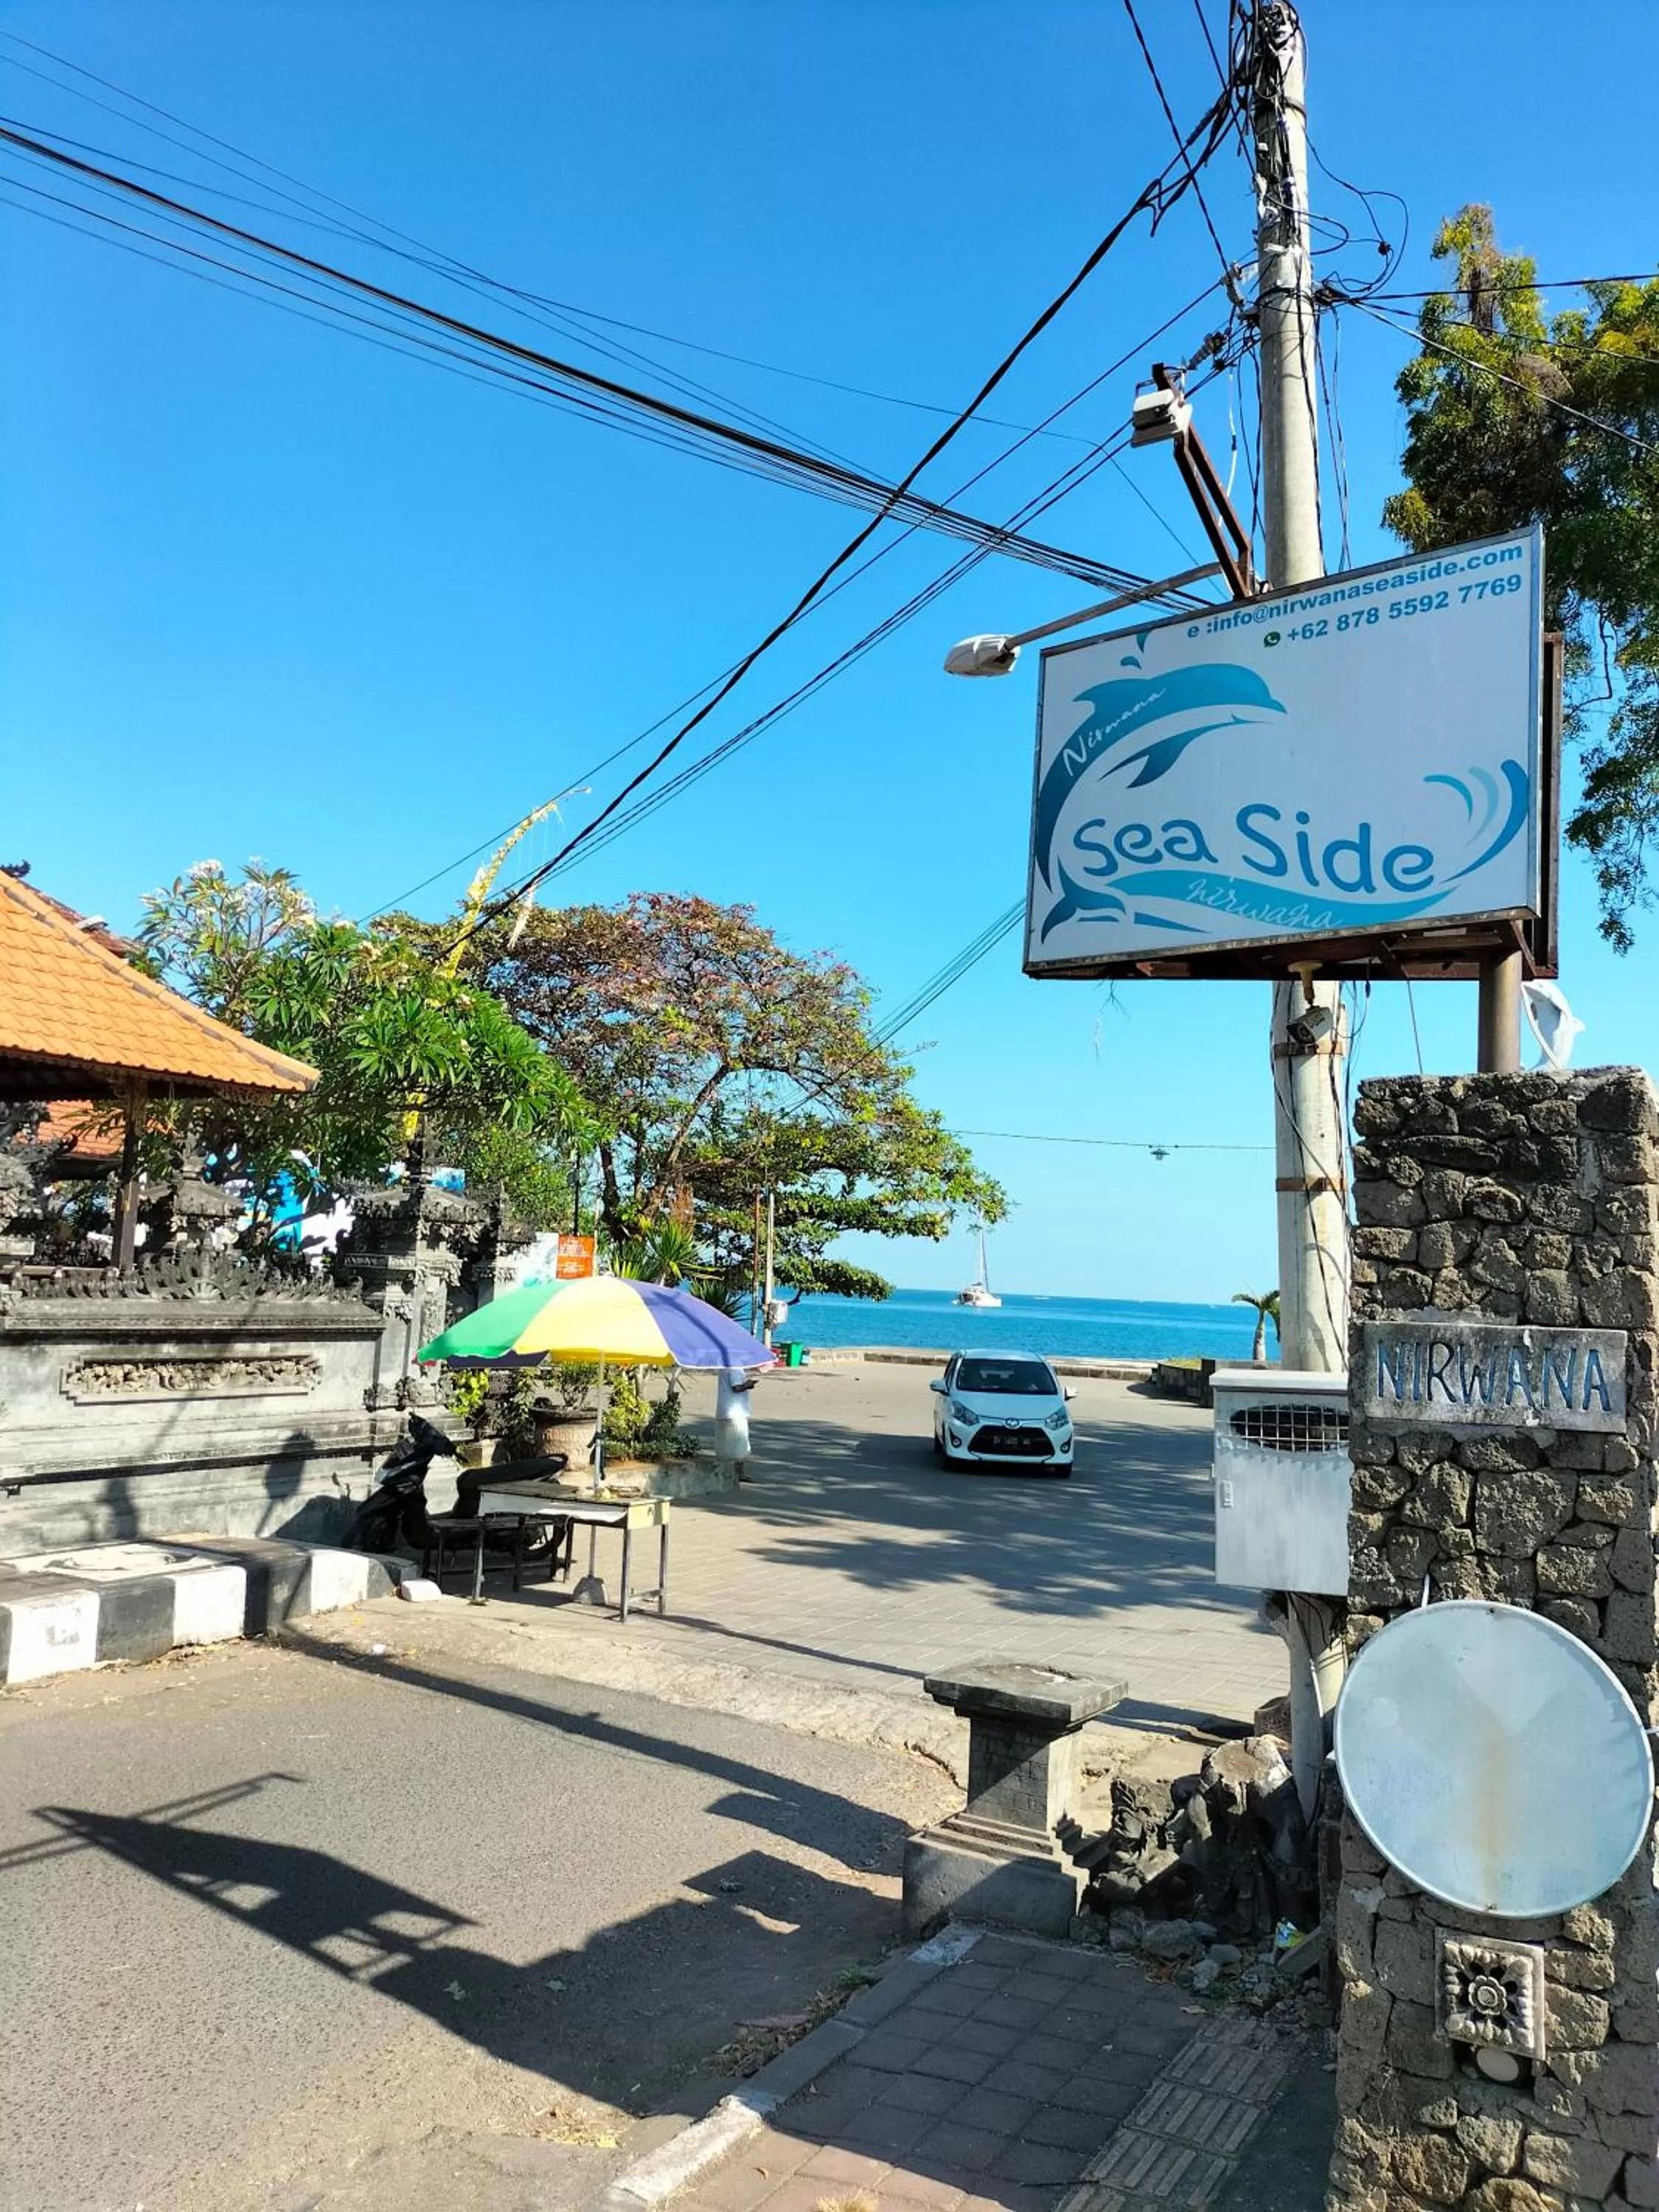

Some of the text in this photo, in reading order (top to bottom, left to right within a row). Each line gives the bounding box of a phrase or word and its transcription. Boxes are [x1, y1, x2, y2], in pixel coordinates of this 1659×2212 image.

[1188, 626, 1200, 638] e
[1287, 574, 1521, 641] +62 878 5592 7769
[1062, 686, 1166, 776] Nirwana
[1237, 803, 1435, 894] Side
[1377, 1340, 1612, 1412] NIRWANA
